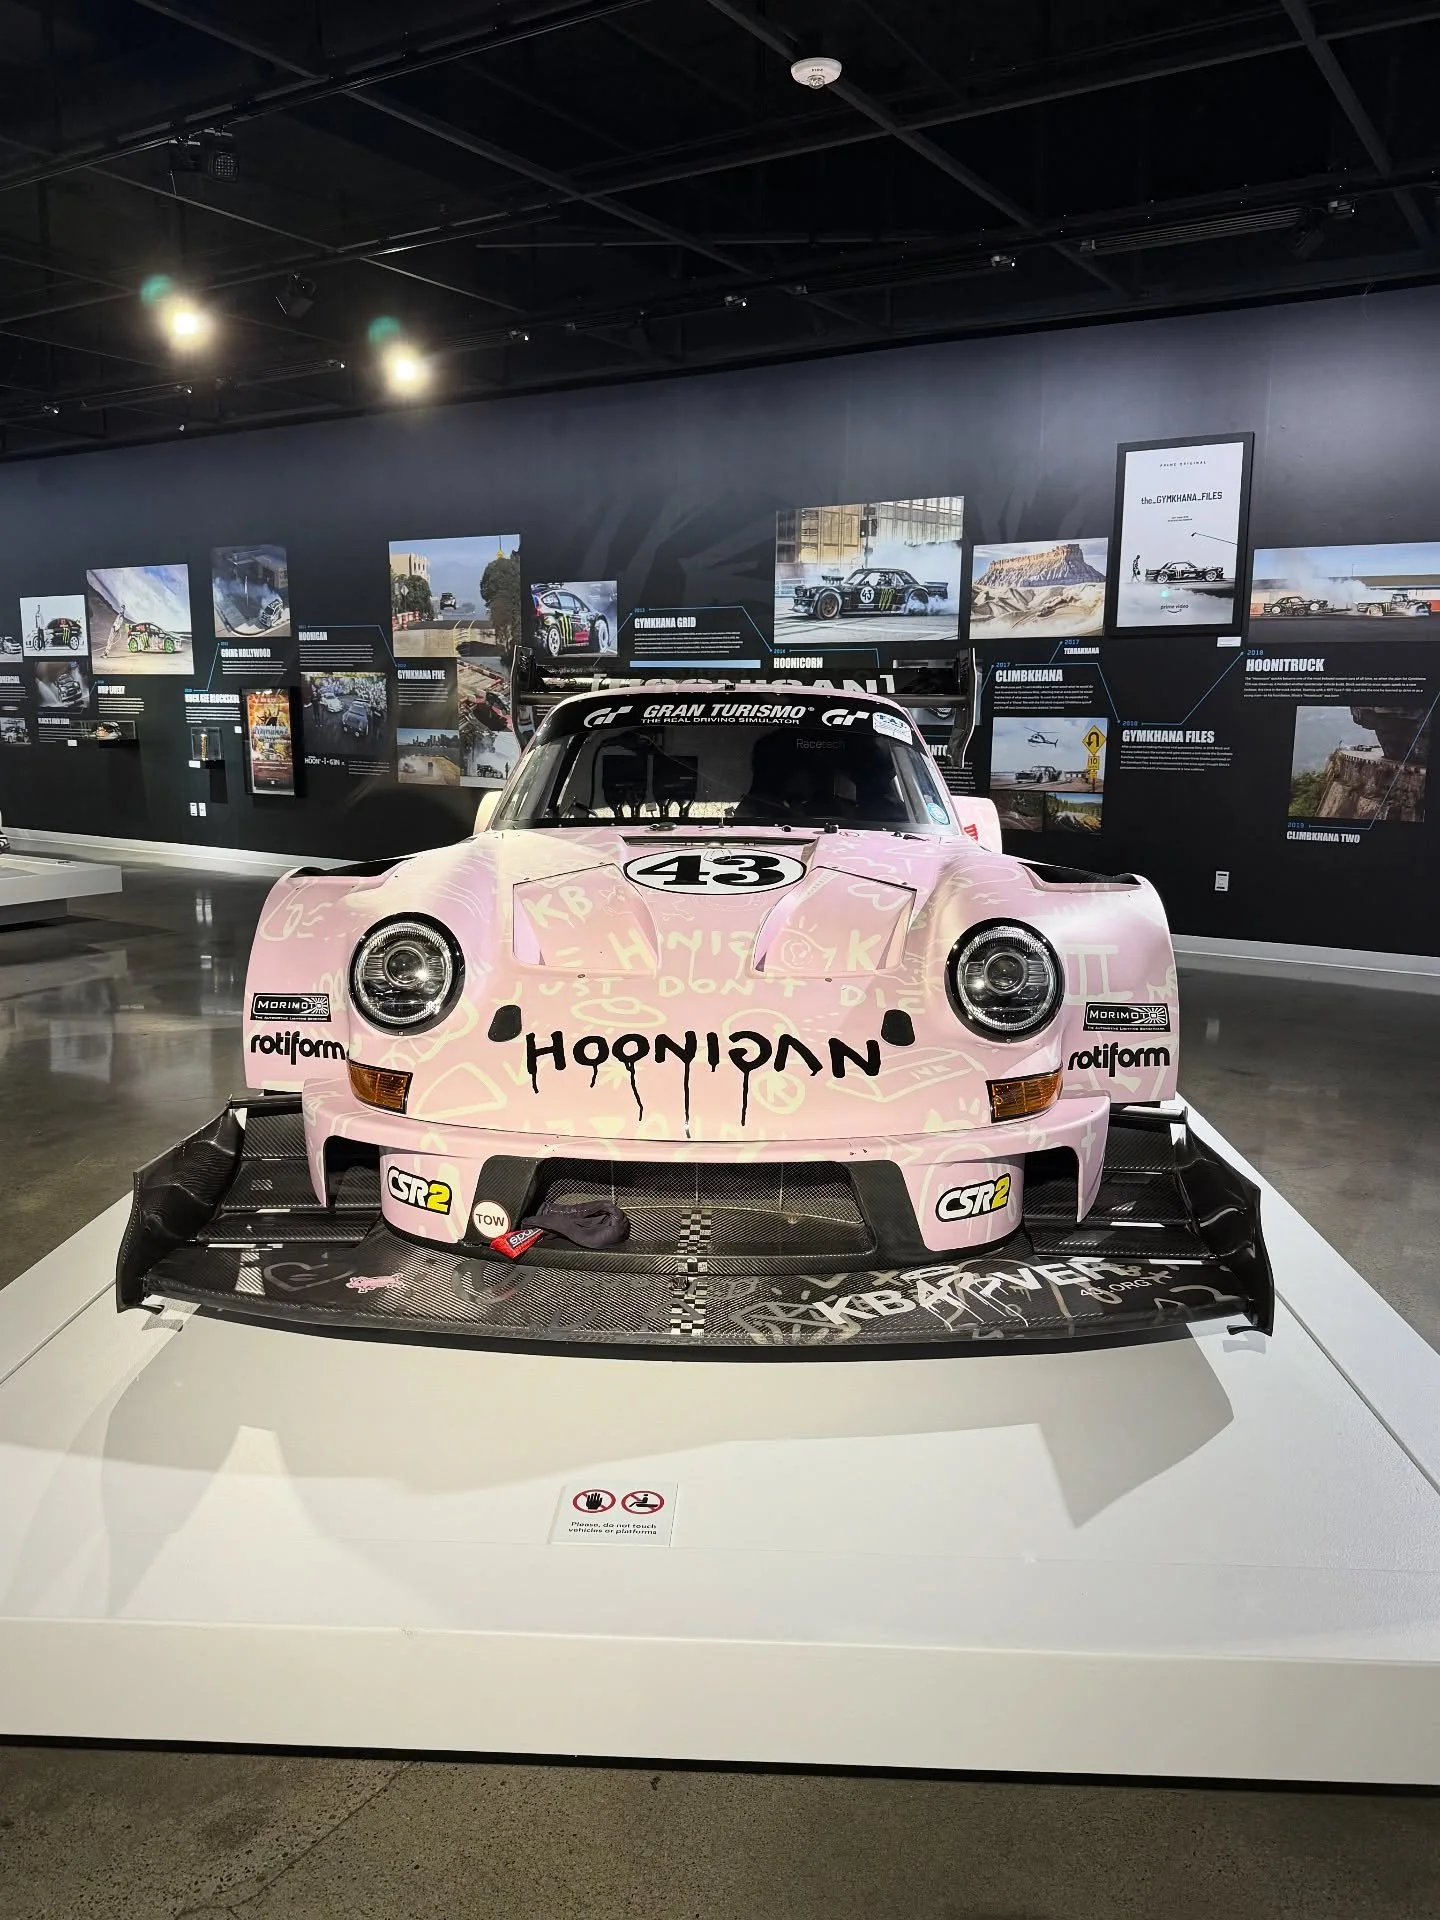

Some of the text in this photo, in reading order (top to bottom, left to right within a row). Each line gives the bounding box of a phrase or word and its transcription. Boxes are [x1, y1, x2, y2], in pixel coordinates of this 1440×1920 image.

[634, 617, 696, 629] GYMKHANA GRID
[1245, 658, 1326, 672] HOONITRUCK
[995, 669, 1063, 682] CLIMBKHANA
[643, 705, 708, 717] GRAN
[1122, 730, 1215, 743] GYMKHANA FILES
[1286, 831, 1361, 843] CLIMBKHANA TWO
[636, 856, 786, 886] 43
[251, 1031, 346, 1065] rotiform
[1068, 1042, 1170, 1077] rotiform
[526, 1030, 881, 1137] HOONIGAN
[387, 1166, 452, 1214] CSR2
[936, 1174, 1010, 1222] CSR2
[475, 1213, 505, 1227] TOW
[616, 1528, 657, 1536] platforms
